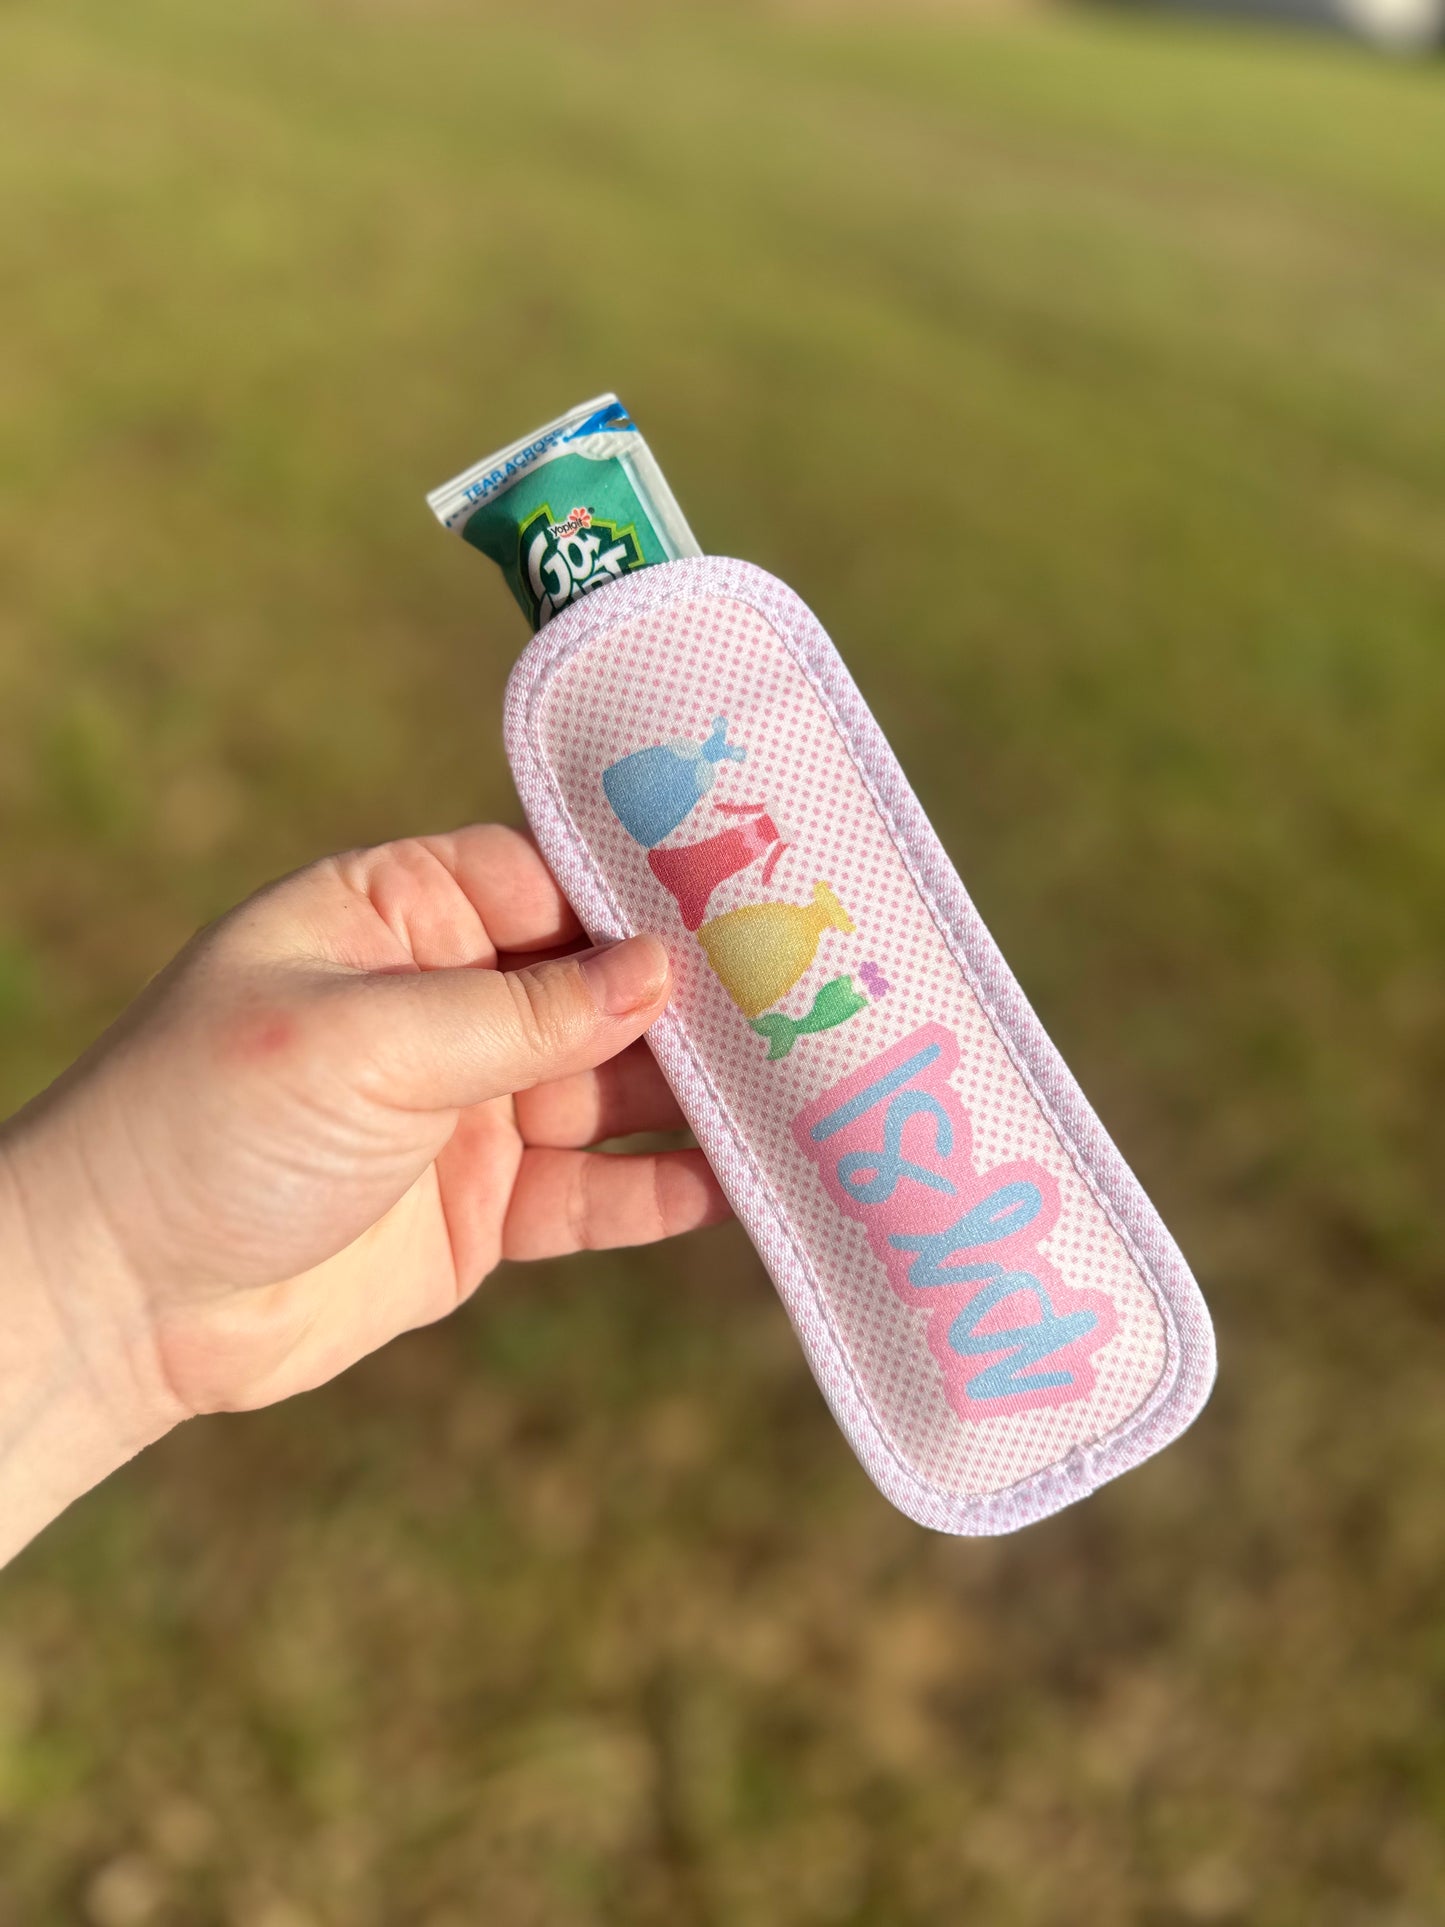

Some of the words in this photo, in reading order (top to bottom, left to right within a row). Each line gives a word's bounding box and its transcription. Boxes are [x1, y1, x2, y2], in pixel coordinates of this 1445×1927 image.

[463, 469, 504, 501] TEAR
[550, 518, 584, 537] Yoplait
[810, 1043, 1099, 1401] Isla
